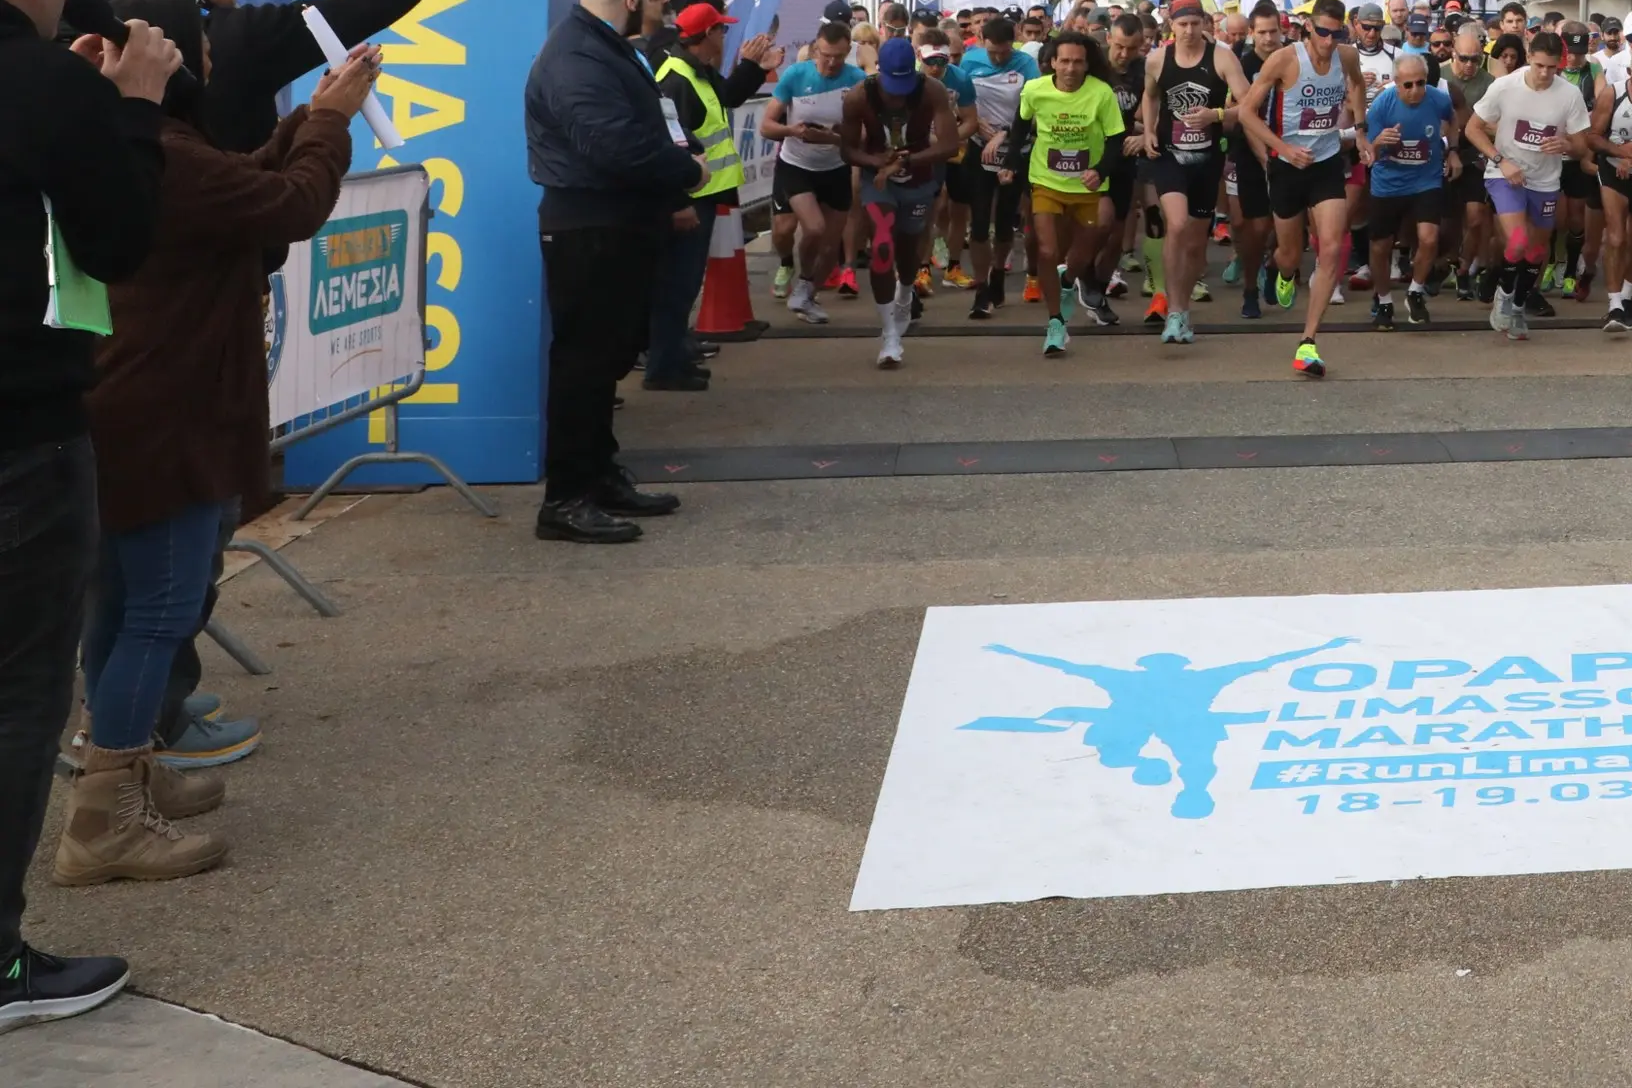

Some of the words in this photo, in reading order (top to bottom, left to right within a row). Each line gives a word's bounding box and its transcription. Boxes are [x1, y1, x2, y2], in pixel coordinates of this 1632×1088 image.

[1296, 98, 1316, 107] AIR
[1308, 118, 1333, 129] 4001
[1180, 132, 1206, 143] 4005
[1521, 132, 1545, 144] 402
[1397, 150, 1422, 159] 4326
[1055, 160, 1081, 171] 4041
[358, 324, 383, 346] SPORTS
